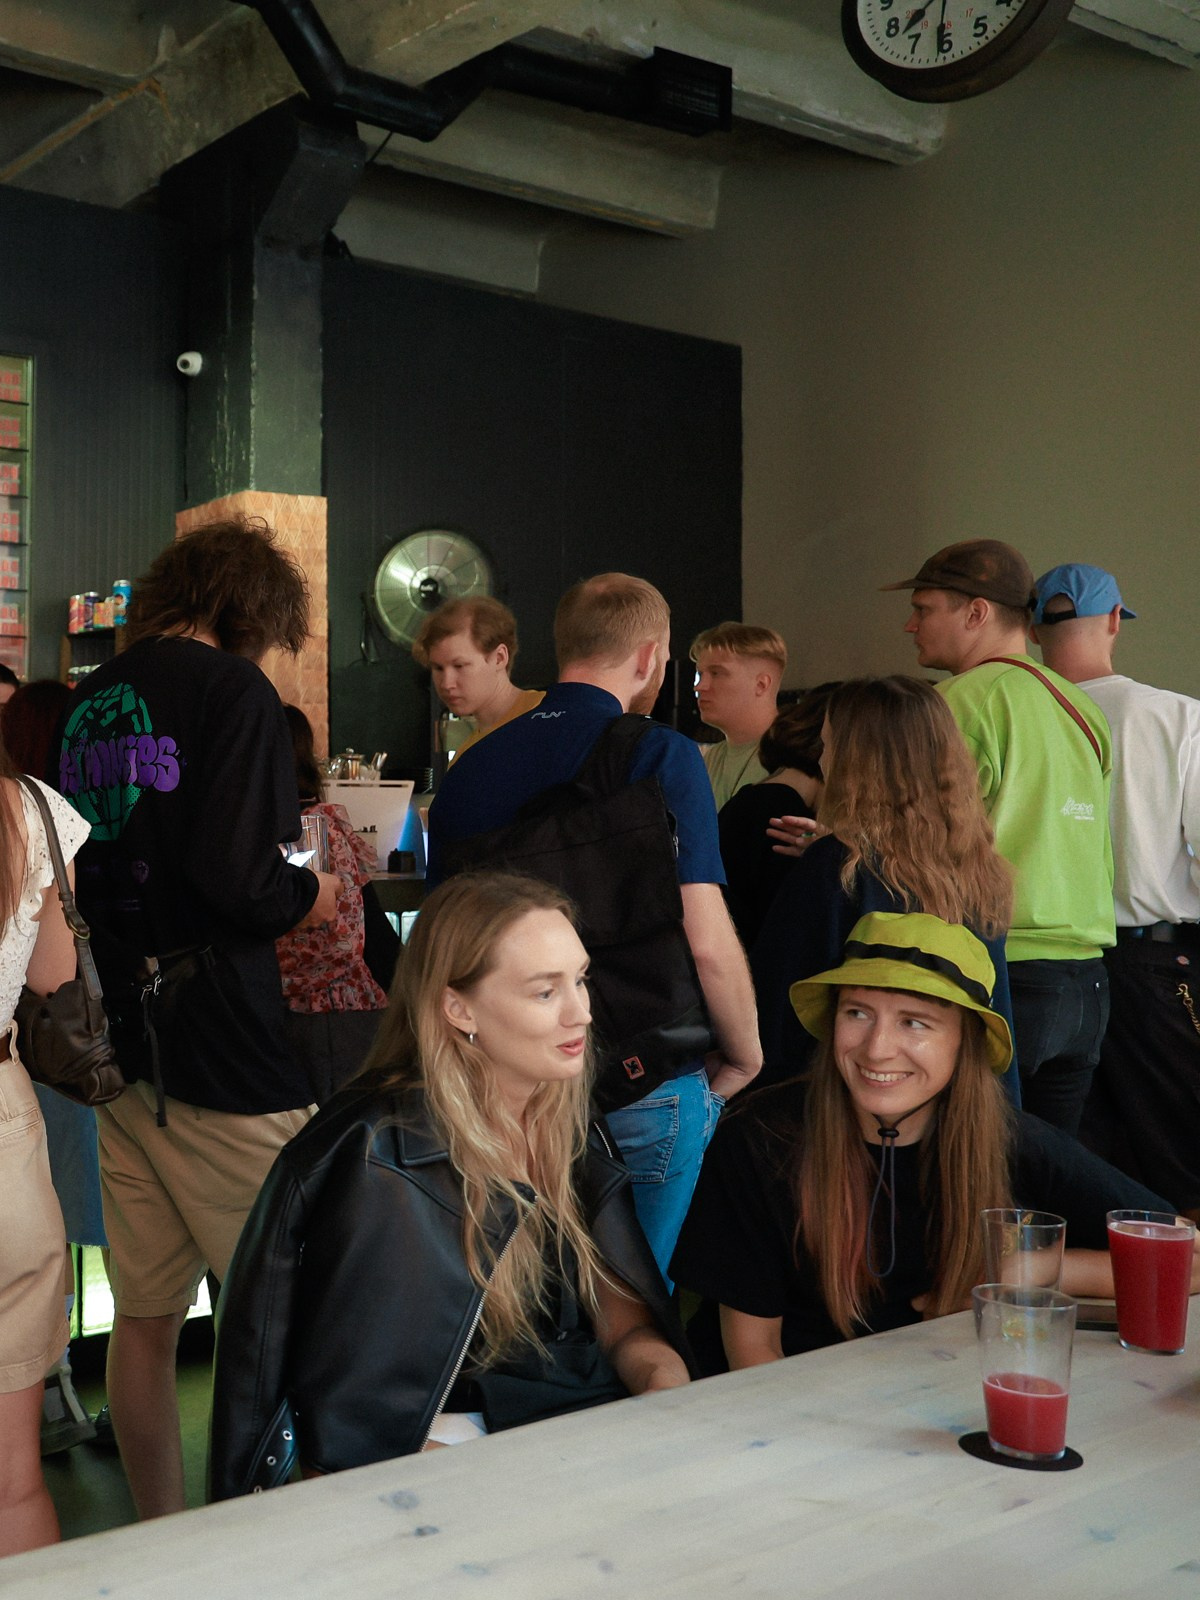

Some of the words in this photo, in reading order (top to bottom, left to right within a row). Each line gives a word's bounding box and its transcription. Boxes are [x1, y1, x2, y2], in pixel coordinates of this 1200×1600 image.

[885, 17, 900, 38] 8
[972, 15, 988, 38] 5
[908, 32, 922, 55] 7
[939, 33, 953, 54] 6
